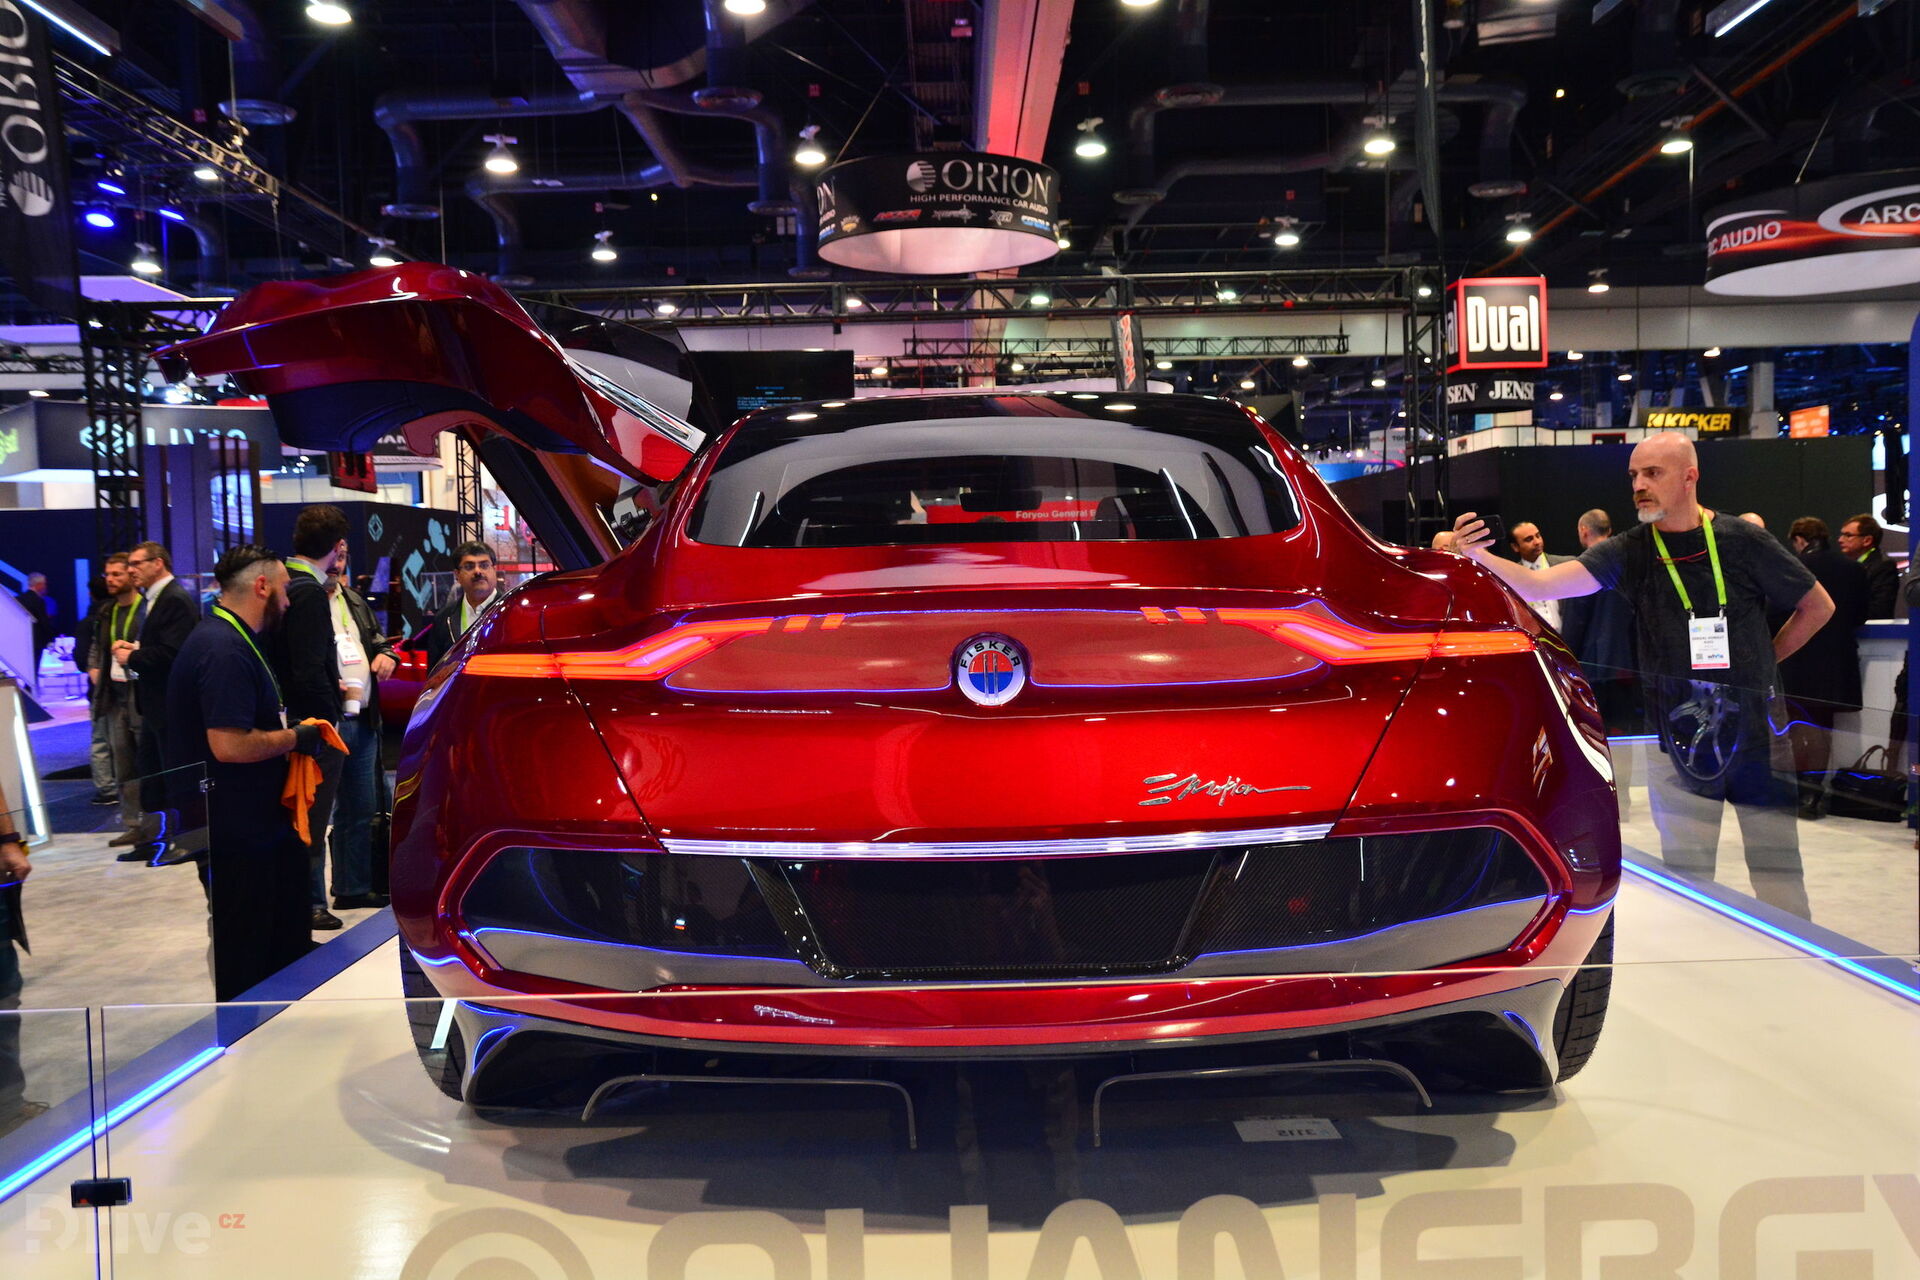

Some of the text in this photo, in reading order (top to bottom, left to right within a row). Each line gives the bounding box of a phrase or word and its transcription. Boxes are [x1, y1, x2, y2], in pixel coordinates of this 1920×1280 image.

[941, 159, 1052, 205] ORION
[910, 194, 1049, 216] HIGH PERFORMANCE CAR AUDIO
[1720, 220, 1782, 251] AUDIO
[1466, 295, 1540, 352] Dual
[1488, 380, 1535, 401] JENS
[1664, 412, 1732, 432] KICKER
[1051, 509, 1088, 518] General
[960, 641, 1021, 669] FISKER
